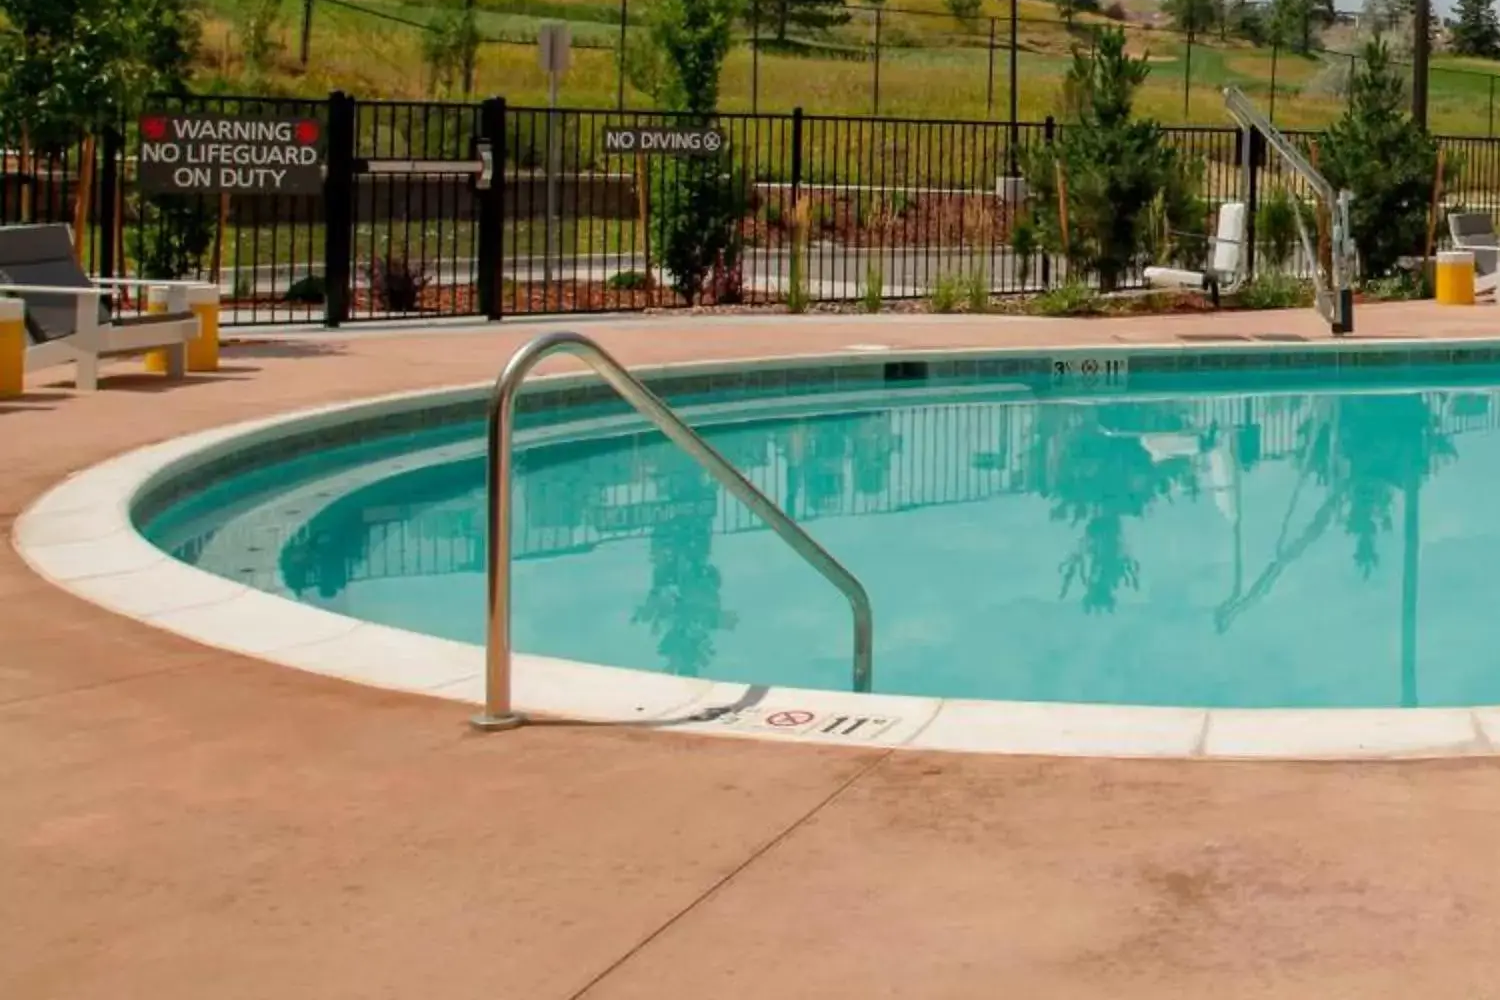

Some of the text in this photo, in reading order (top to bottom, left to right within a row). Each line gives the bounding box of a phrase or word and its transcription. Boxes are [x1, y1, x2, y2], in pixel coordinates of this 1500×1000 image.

[172, 119, 292, 141] WARNING
[607, 131, 701, 149] NO DIVING
[142, 142, 317, 165] NO LIFEGUARD
[174, 167, 287, 188] ON DUTY
